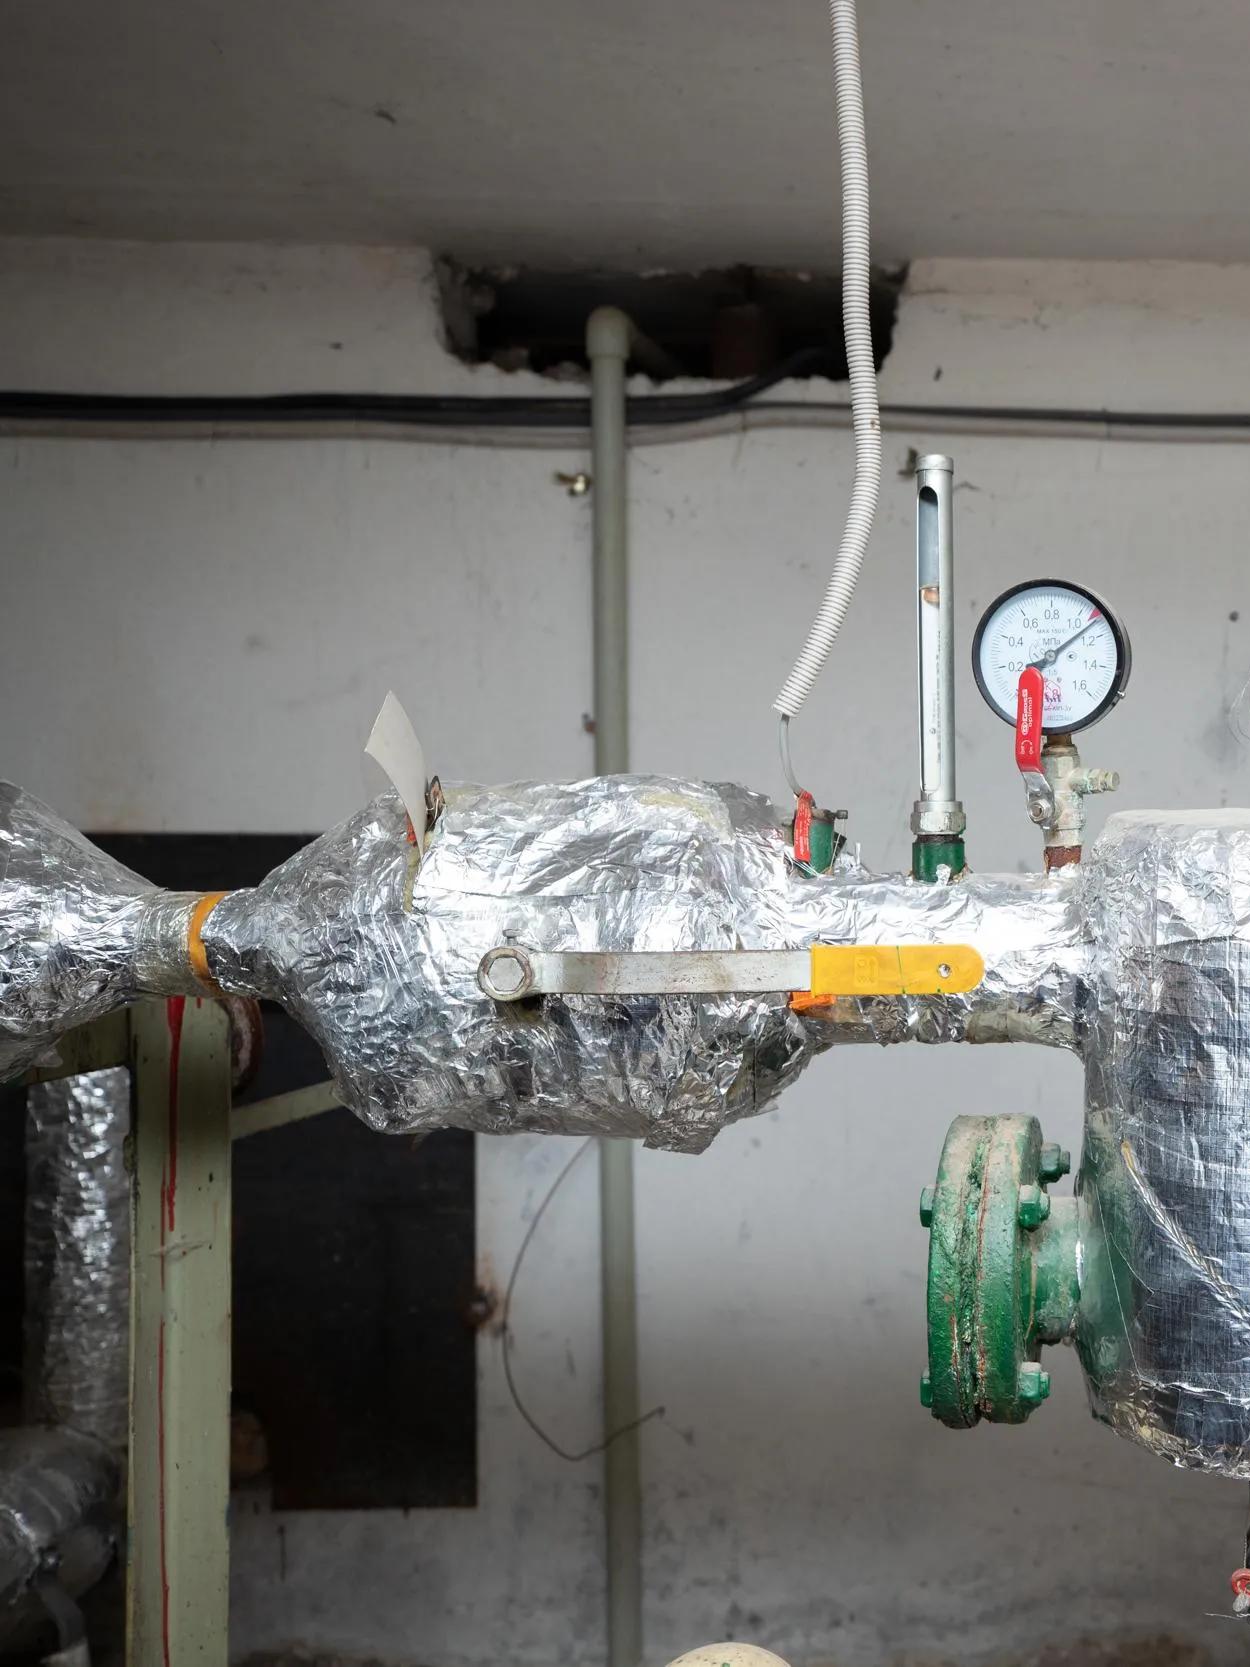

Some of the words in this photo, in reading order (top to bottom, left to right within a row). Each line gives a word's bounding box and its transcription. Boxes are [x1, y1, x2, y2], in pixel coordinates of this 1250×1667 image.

[1044, 609, 1060, 620] 0,8
[1023, 618, 1039, 630] 0,6
[1067, 618, 1081, 630] 1,0
[1008, 636, 1023, 648] 0,4
[1081, 635, 1095, 648] 1,2
[1008, 661, 1024, 672] 0,2
[1084, 660, 1097, 671] 1,4
[1073, 680, 1087, 691] 1,6
